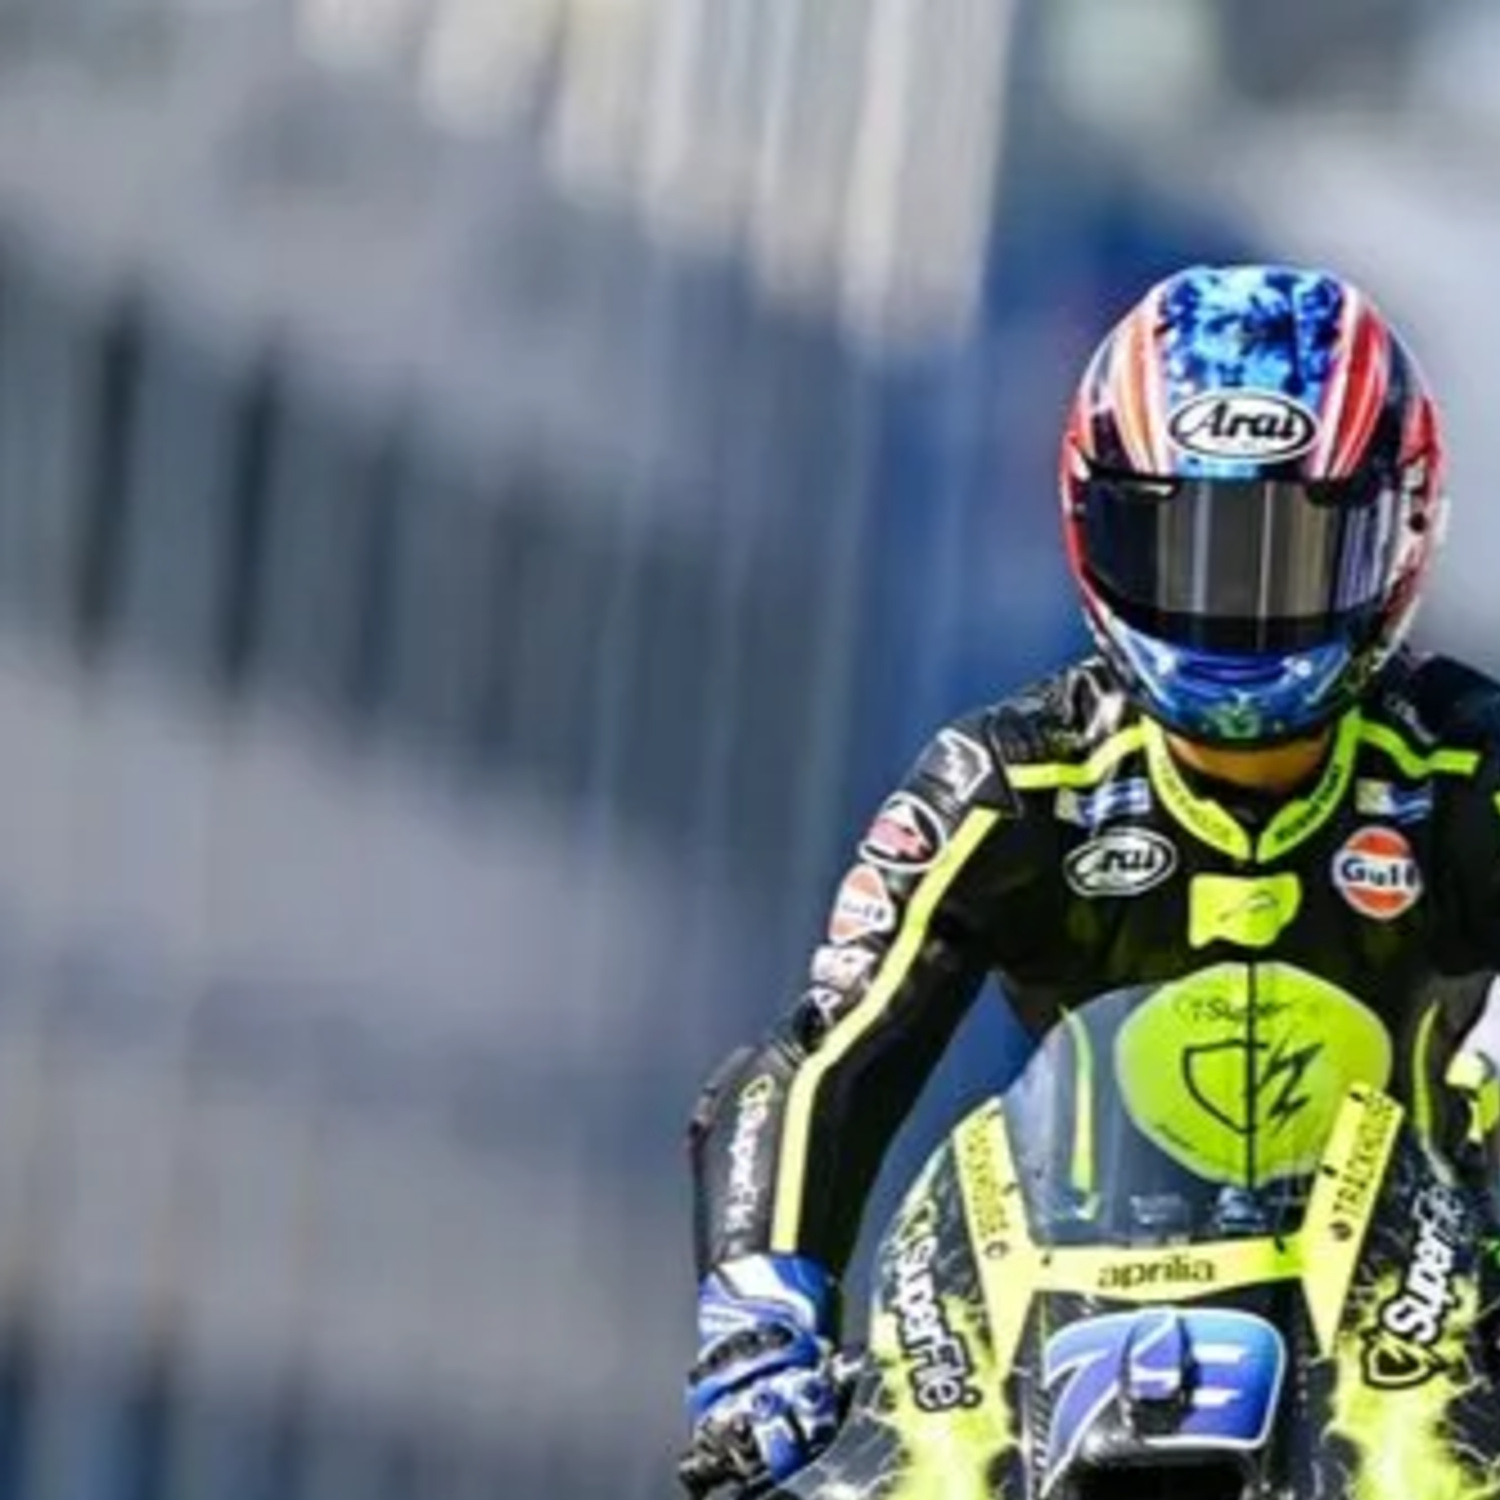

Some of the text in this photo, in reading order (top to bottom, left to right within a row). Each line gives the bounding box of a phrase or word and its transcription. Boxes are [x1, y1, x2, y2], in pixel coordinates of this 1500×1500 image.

[1185, 402, 1299, 440] Arai
[1097, 1254, 1217, 1289] aprilia
[1042, 1306, 1288, 1490] 79
